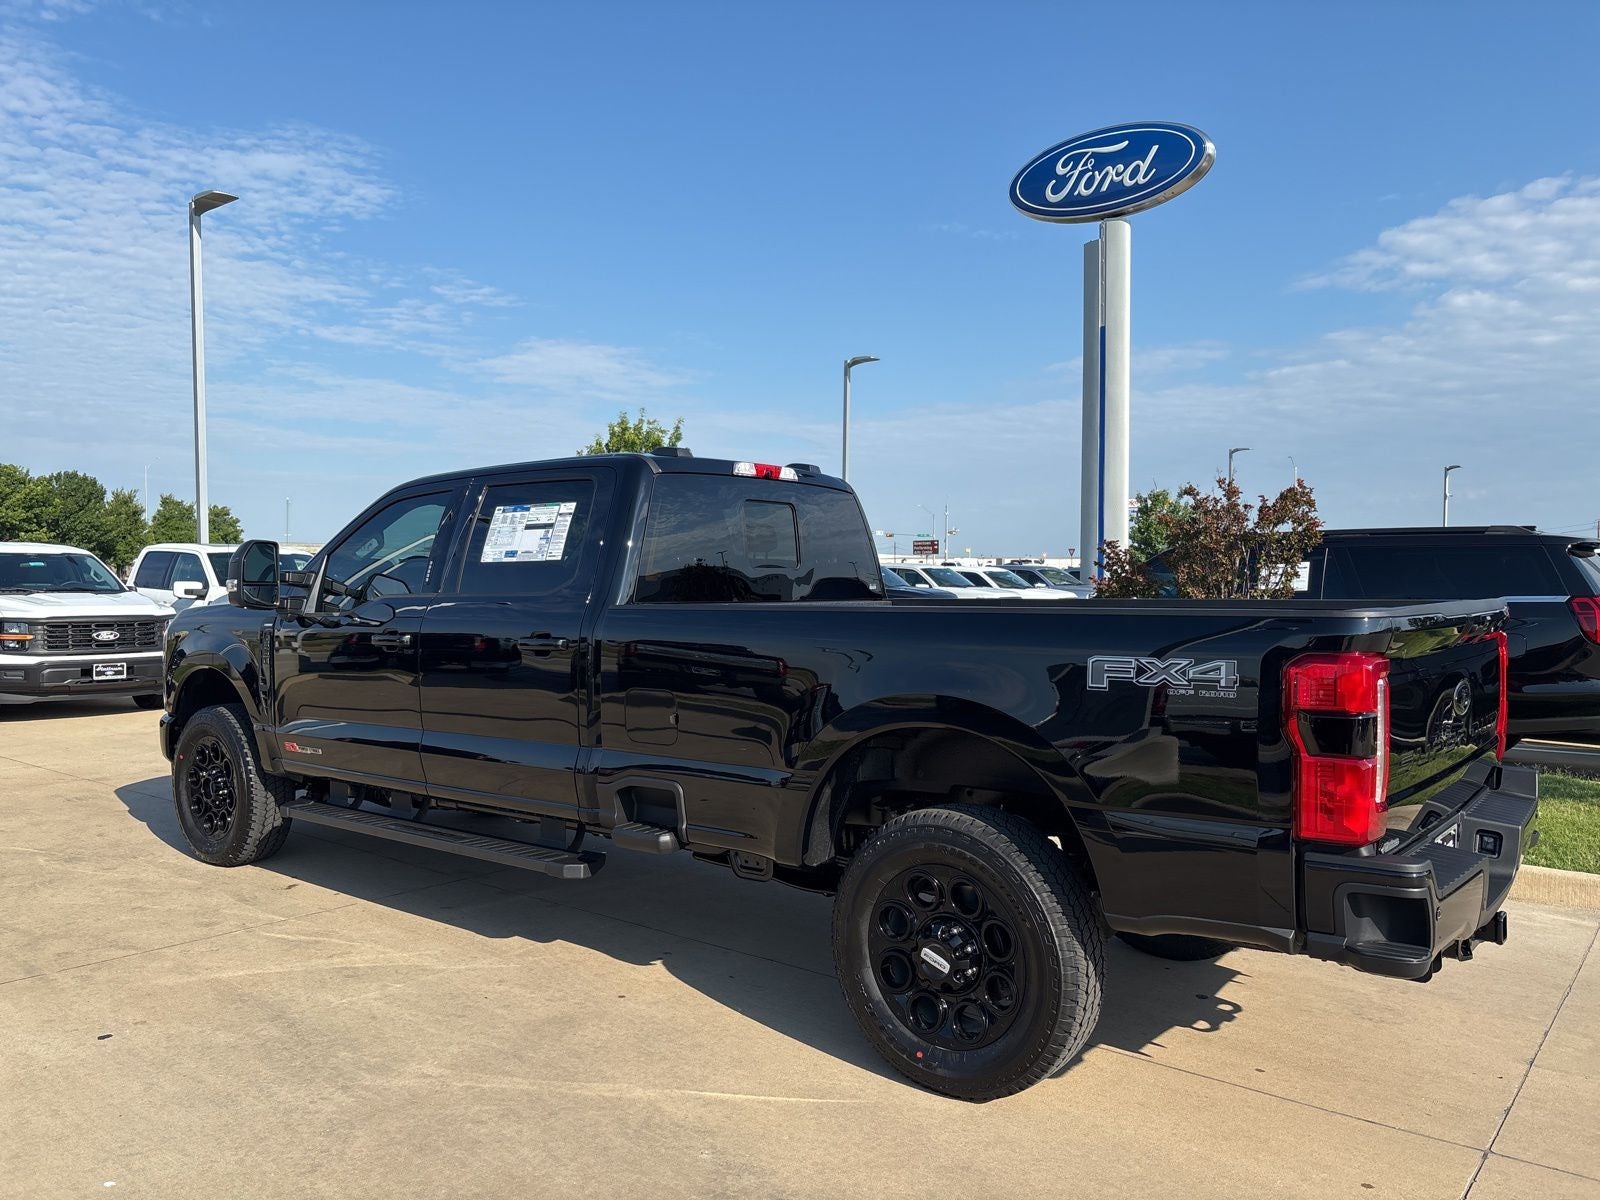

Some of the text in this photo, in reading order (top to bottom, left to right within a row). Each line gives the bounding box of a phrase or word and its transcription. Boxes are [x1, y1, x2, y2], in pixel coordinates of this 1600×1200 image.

[1045, 140, 1160, 203] Ford
[1087, 655, 1240, 692] FX4
[1199, 690, 1237, 699] ROAD
[923, 952, 946, 970] FORD
